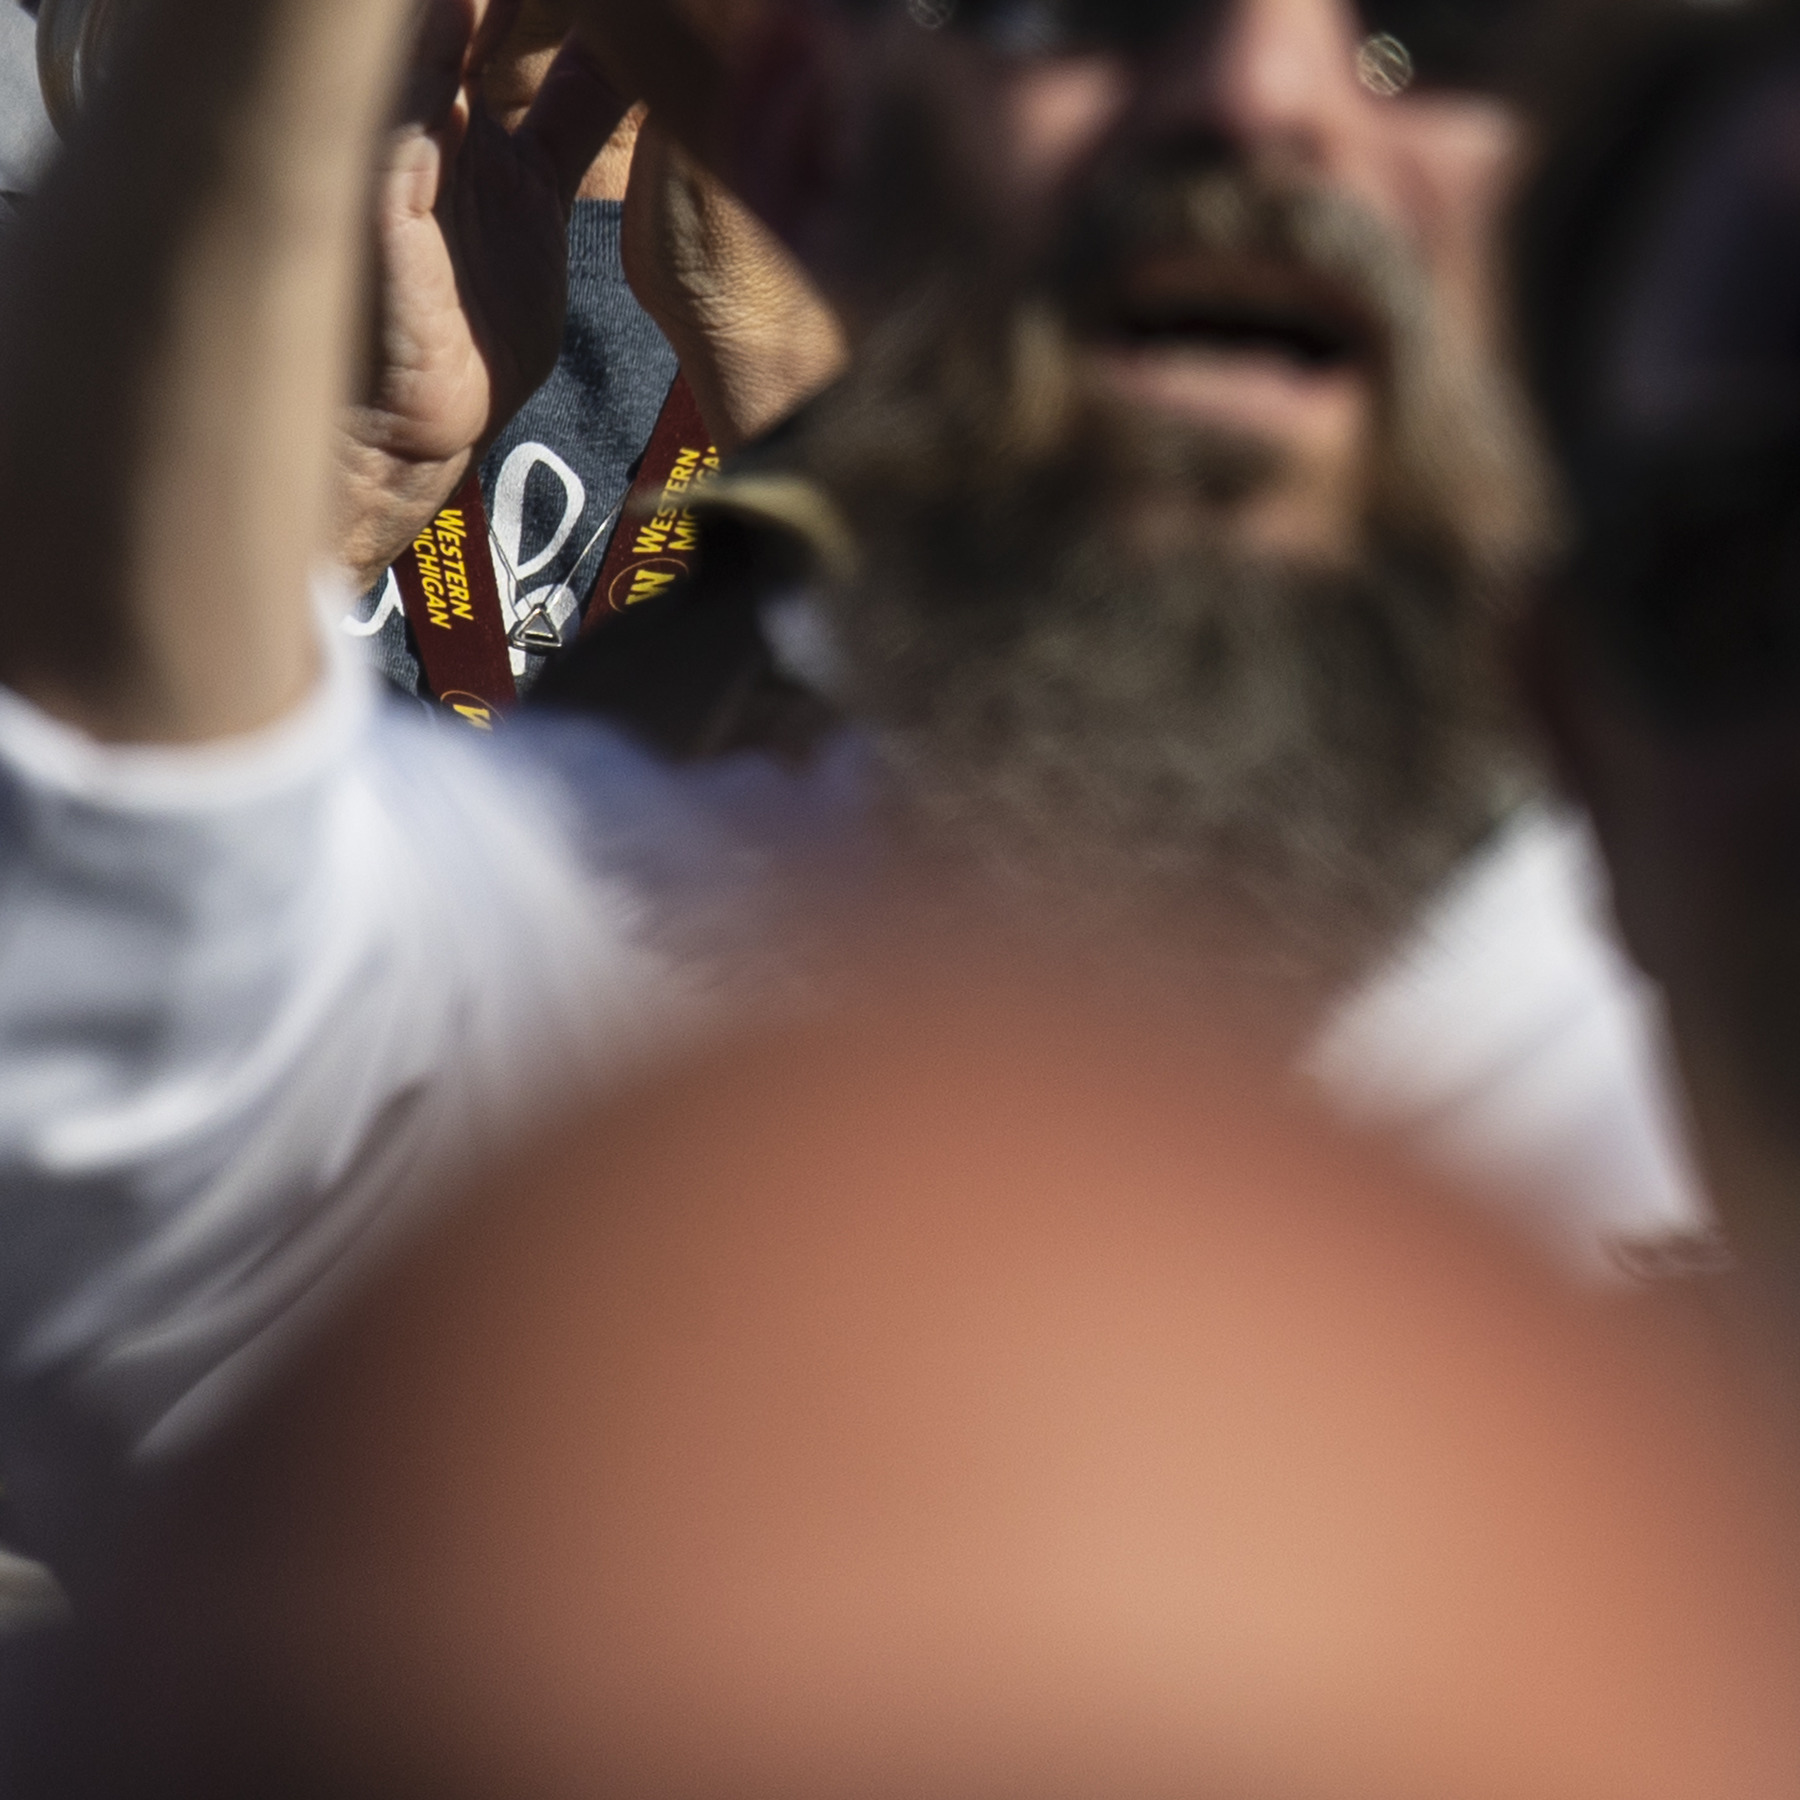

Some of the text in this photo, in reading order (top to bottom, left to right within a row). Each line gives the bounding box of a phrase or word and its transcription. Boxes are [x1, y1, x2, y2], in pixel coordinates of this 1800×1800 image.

[632, 447, 701, 553] WESTERN
[412, 527, 452, 630] ICHIGAN
[434, 508, 475, 621] WESTERN
